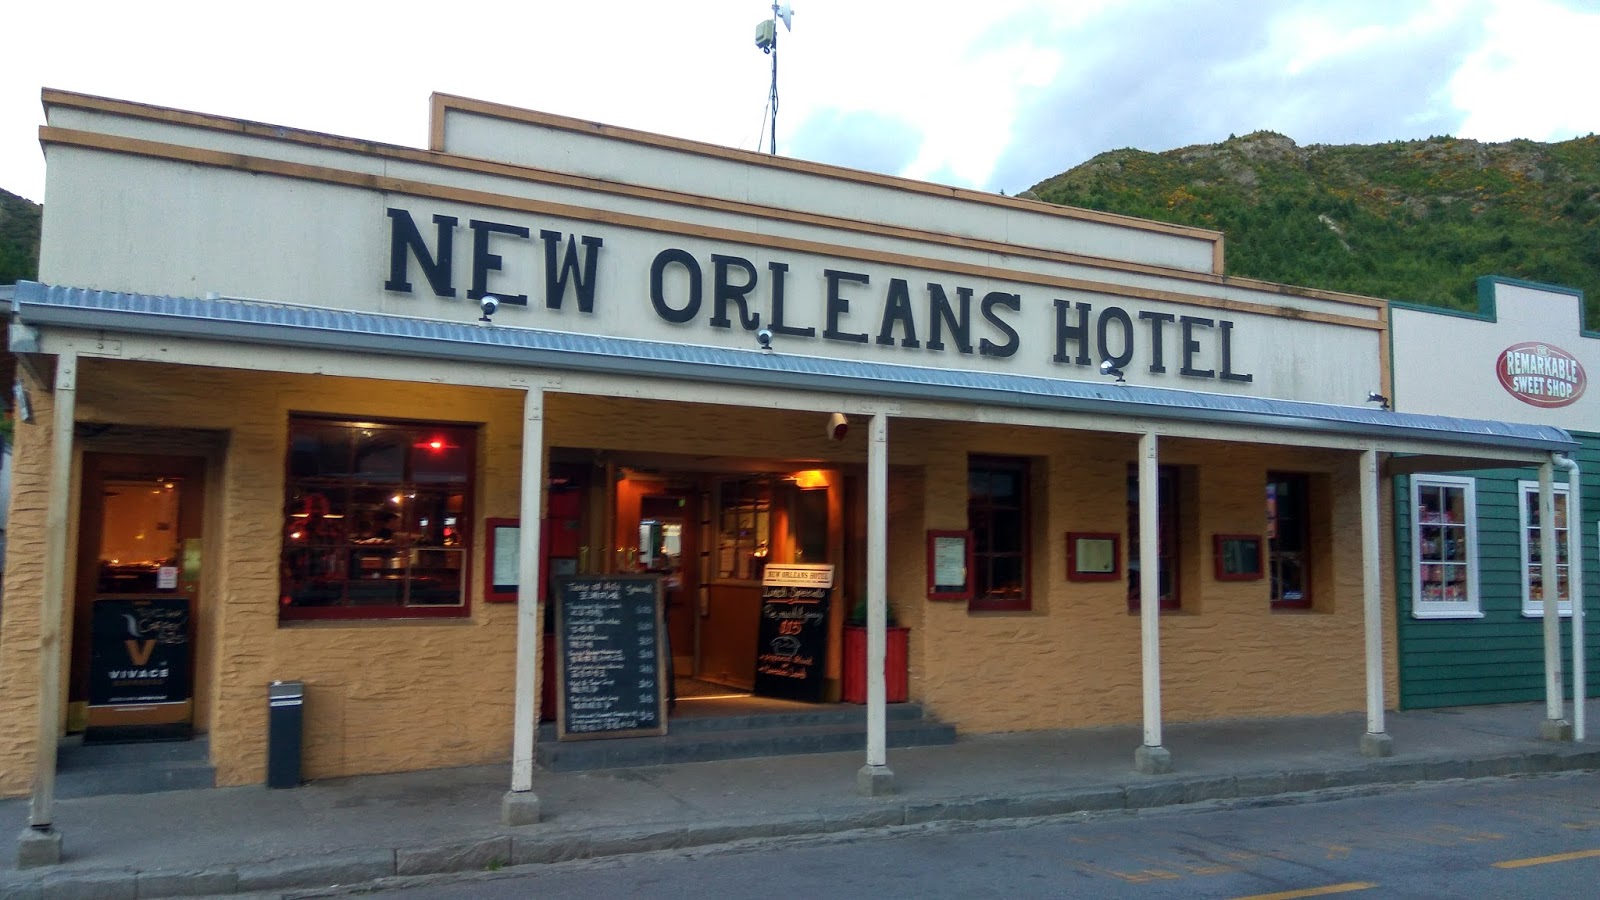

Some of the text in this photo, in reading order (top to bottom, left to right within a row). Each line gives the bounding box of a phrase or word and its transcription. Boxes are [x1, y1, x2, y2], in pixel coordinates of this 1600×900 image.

[384, 207, 1253, 382] NEW ORLEANS HOTEL
[1506, 351, 1578, 384] REMARKABLE
[1513, 376, 1573, 398] SWEET SHOP
[781, 571, 809, 580] ORLEANS
[809, 572, 829, 580] HOTEL
[108, 669, 169, 679] VIVACE
